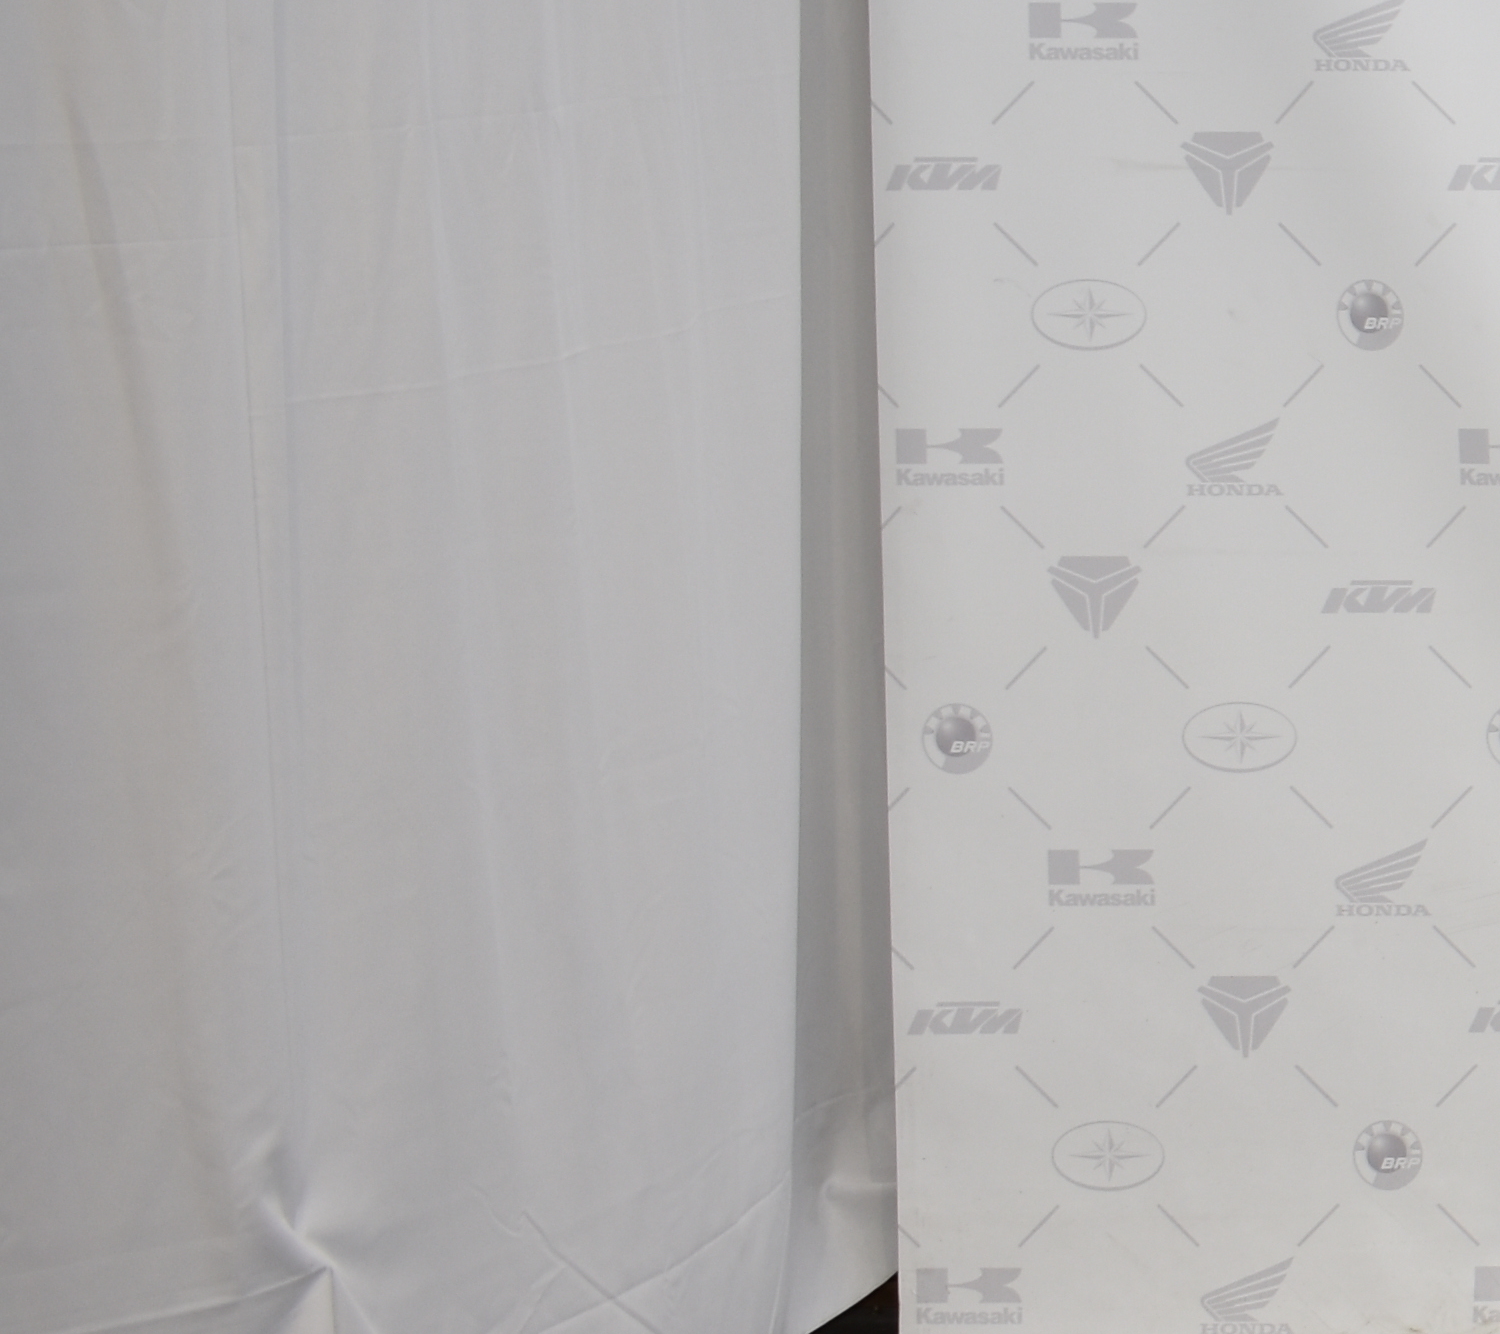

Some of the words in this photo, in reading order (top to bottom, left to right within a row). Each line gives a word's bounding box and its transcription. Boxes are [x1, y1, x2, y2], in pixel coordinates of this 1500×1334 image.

[1029, 43, 1138, 60] Kawasaki
[1312, 57, 1410, 72] HONDA
[885, 154, 1001, 192] KTM
[895, 466, 1003, 488] Kawasaki
[1187, 481, 1283, 496] HONDA
[1321, 580, 1435, 614] KTM
[1048, 889, 1155, 906] Kawasaki
[1336, 902, 1431, 917] HONDA
[906, 1002, 1022, 1036] KTM
[915, 1305, 1023, 1327] Kawasaki
[1200, 1320, 1293, 1334] HONDA
